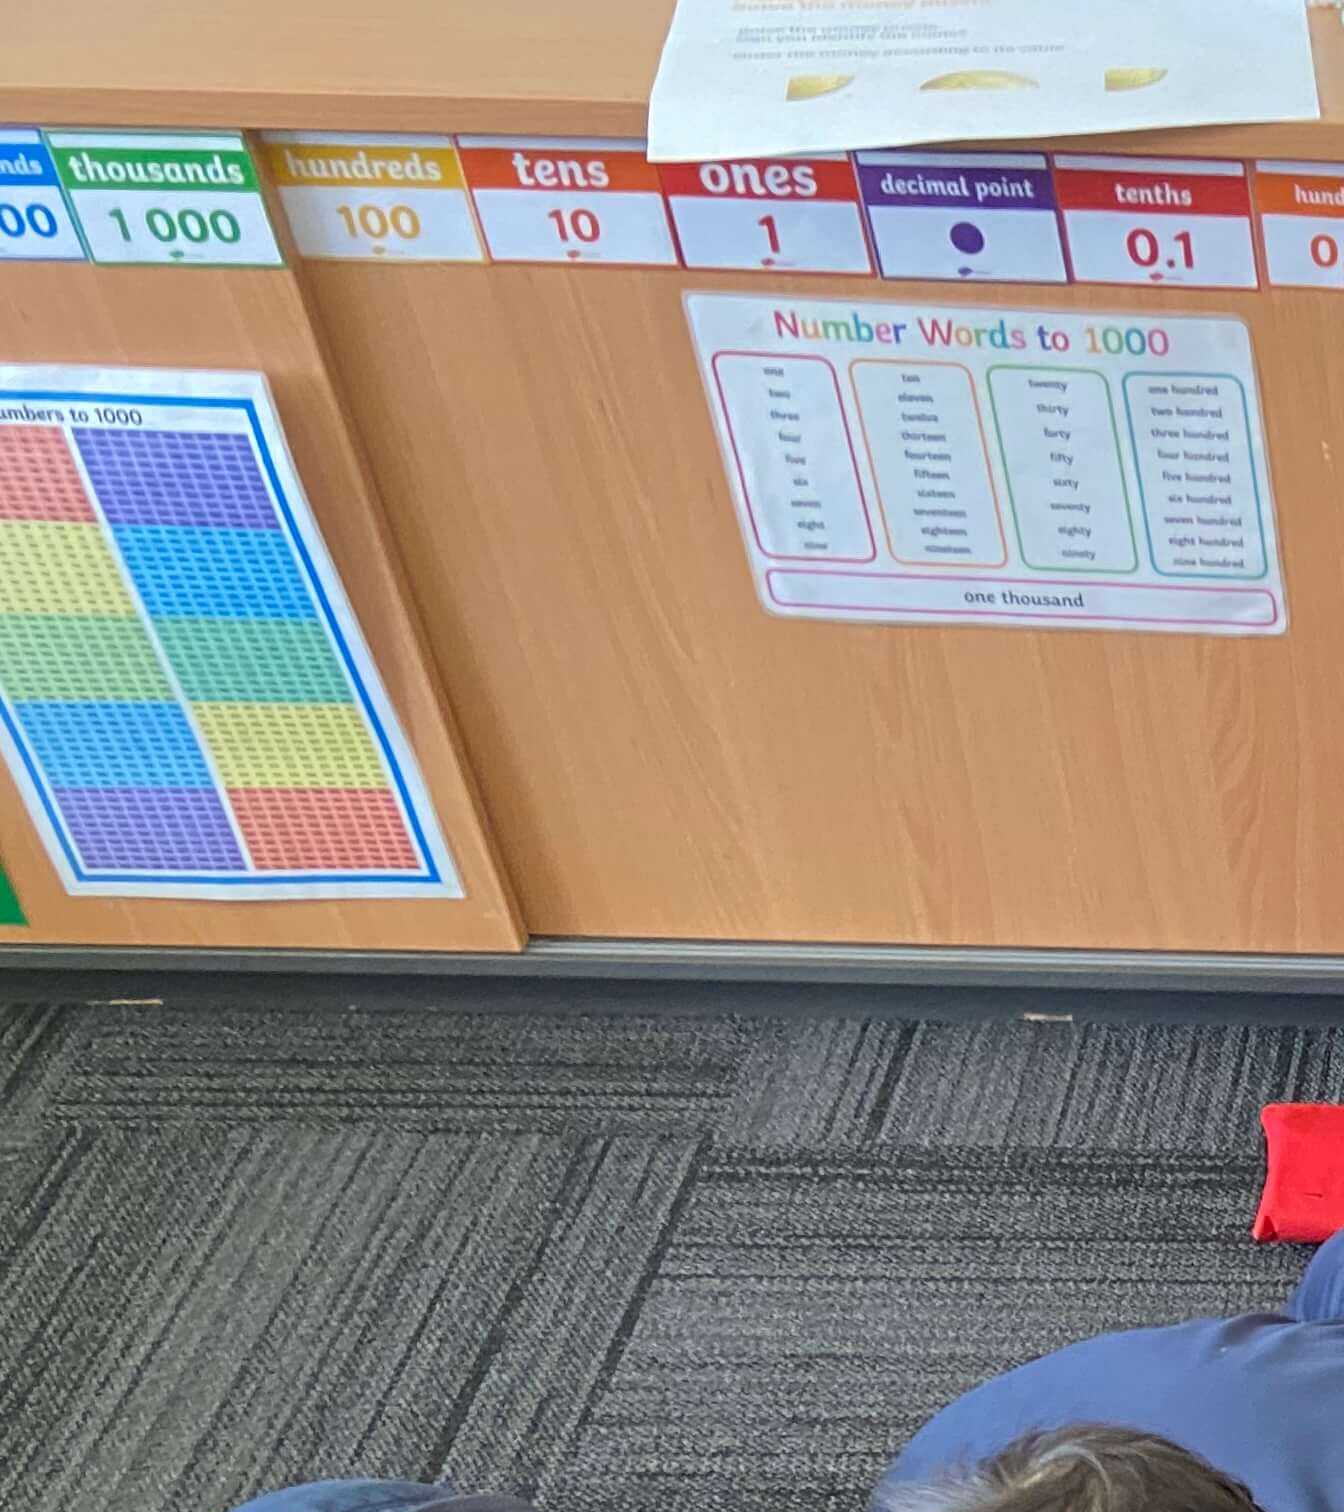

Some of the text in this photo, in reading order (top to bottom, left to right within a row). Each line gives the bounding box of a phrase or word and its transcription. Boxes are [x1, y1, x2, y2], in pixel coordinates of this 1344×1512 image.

[68, 152, 244, 184] thousands
[285, 150, 442, 182] hundreds
[512, 152, 609, 189] tens
[701, 162, 818, 196] ones
[881, 174, 1034, 202] decimal point
[1115, 180, 1192, 208] tenths
[109, 209, 131, 242] 1
[336, 205, 420, 239] 100
[548, 209, 600, 244] 10
[758, 216, 780, 254] 1
[1126, 228, 1194, 270] 0.1
[775, 310, 1169, 356] Number Words to 1000
[69, 408, 89, 422] to
[94, 407, 143, 426] 1000
[964, 591, 1085, 608] one thousand
